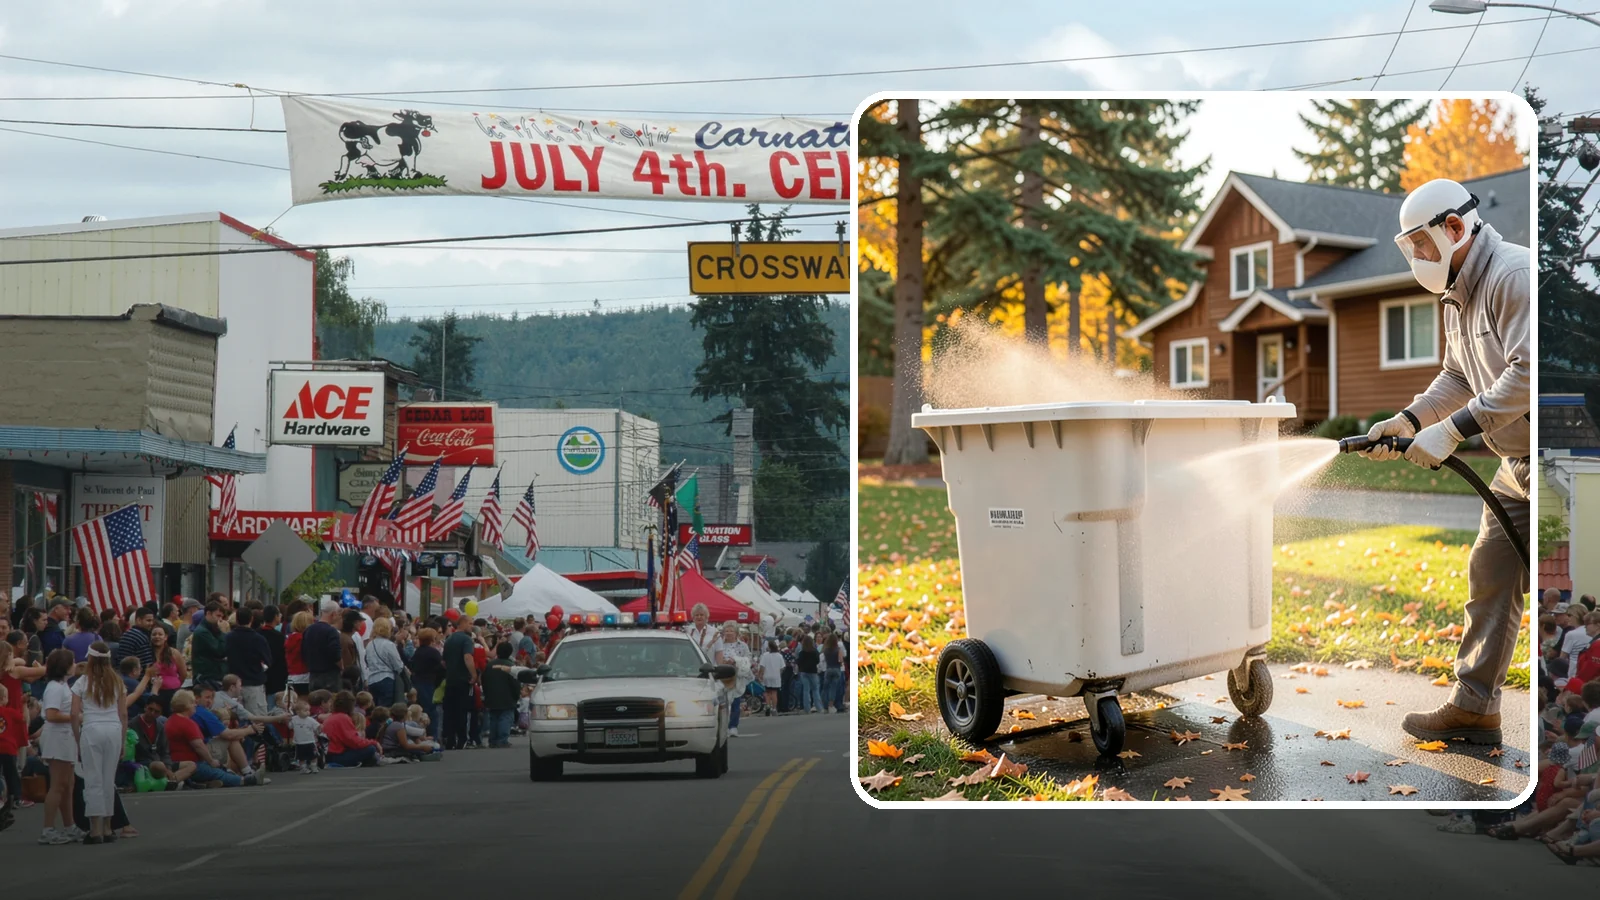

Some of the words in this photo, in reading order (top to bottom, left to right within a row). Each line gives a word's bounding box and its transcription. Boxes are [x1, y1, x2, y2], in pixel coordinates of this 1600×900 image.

[481, 141, 605, 192] JULY
[632, 150, 746, 198] 4th.
[697, 254, 850, 280] CROSSWA
[283, 380, 373, 420] ACE
[406, 409, 452, 422] CEDAR
[461, 409, 485, 422] LOG
[284, 421, 371, 437] Hardware
[416, 428, 477, 447] Coca-Cola
[354, 467, 385, 480] Simpl
[83, 485, 94, 494] St.
[95, 485, 124, 495] Vincent
[126, 485, 136, 495] de
[137, 486, 155, 495] Paul
[688, 526, 741, 535] CRNATION
[699, 535, 730, 543] GLASS
